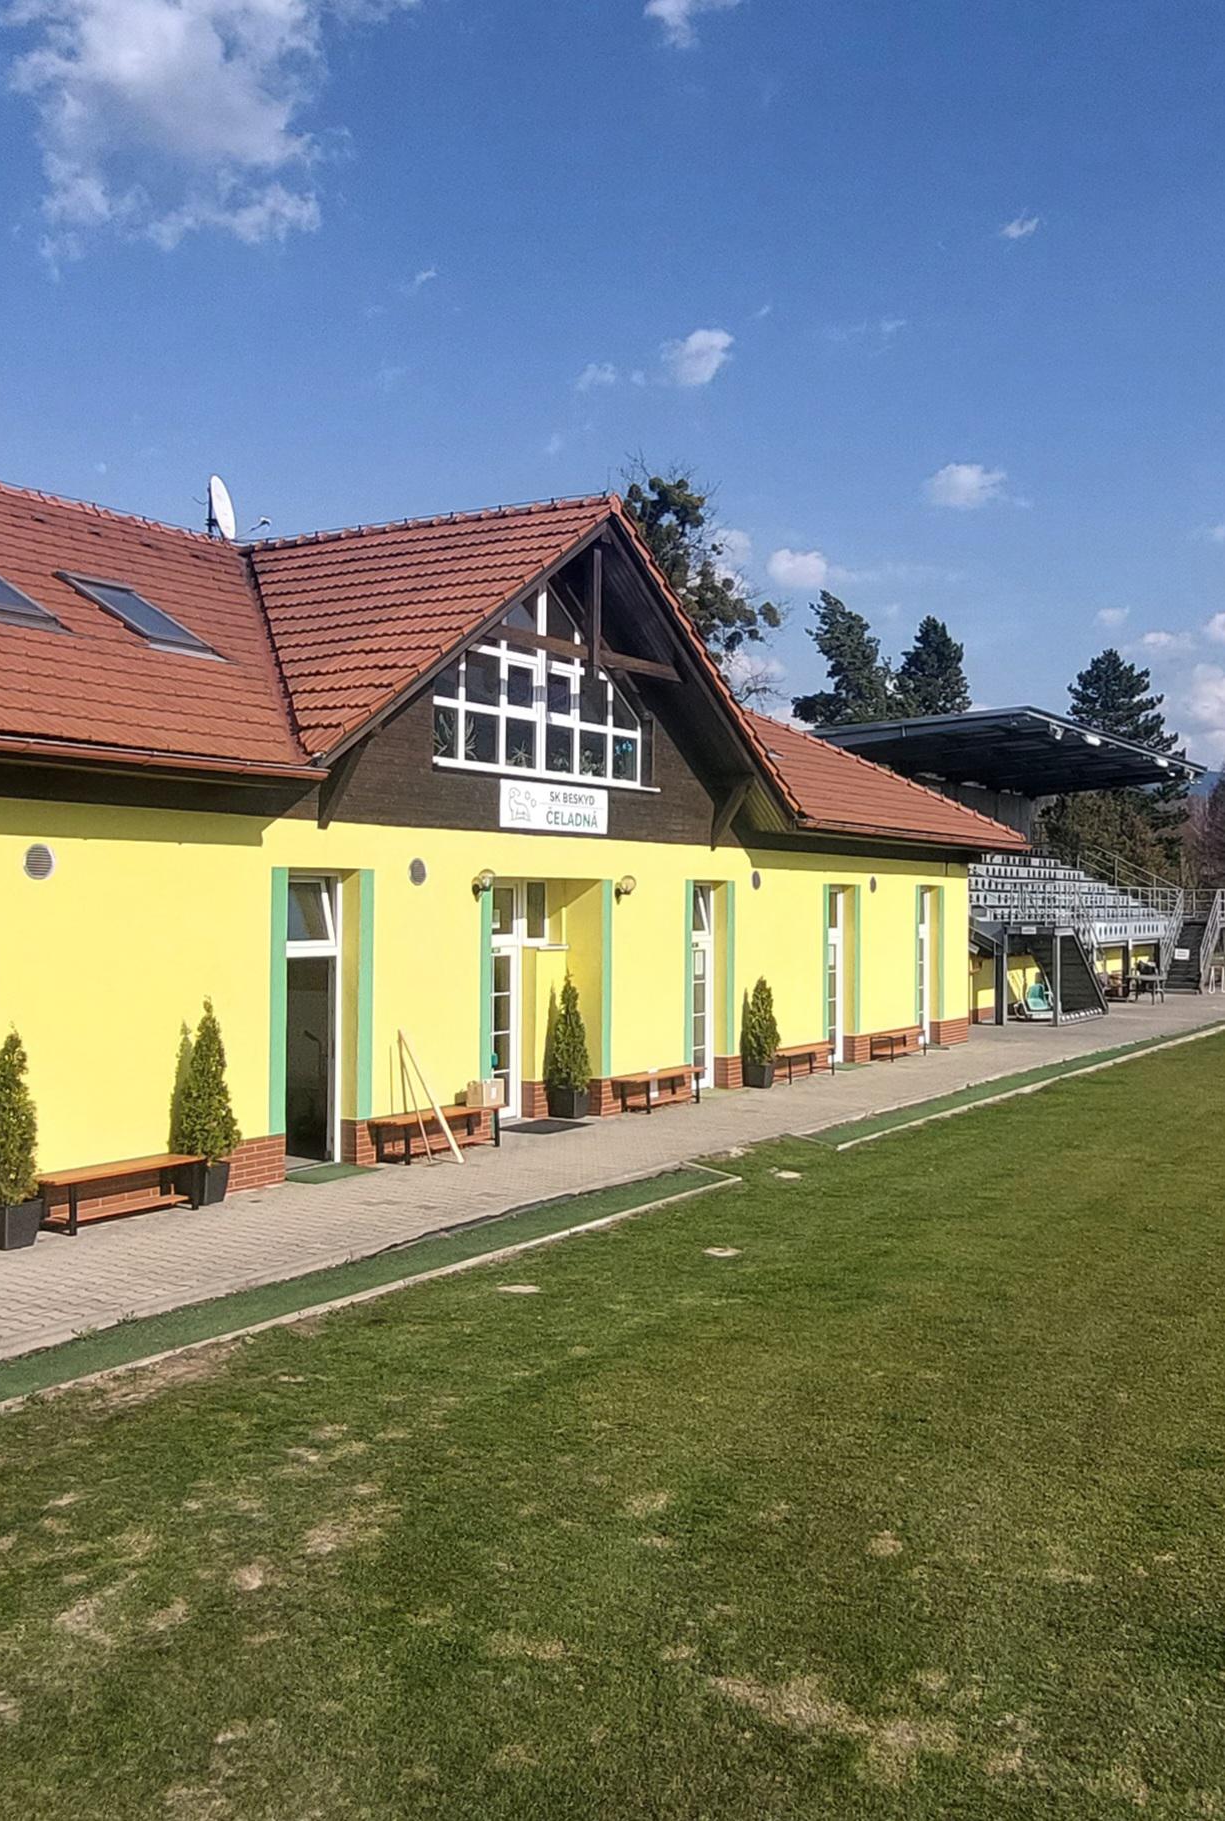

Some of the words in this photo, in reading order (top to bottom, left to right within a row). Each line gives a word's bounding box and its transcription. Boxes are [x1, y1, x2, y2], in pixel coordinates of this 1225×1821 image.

[550, 791, 561, 803] SK
[563, 793, 595, 806] BESKYD
[546, 807, 598, 828] ČELADNÁ
